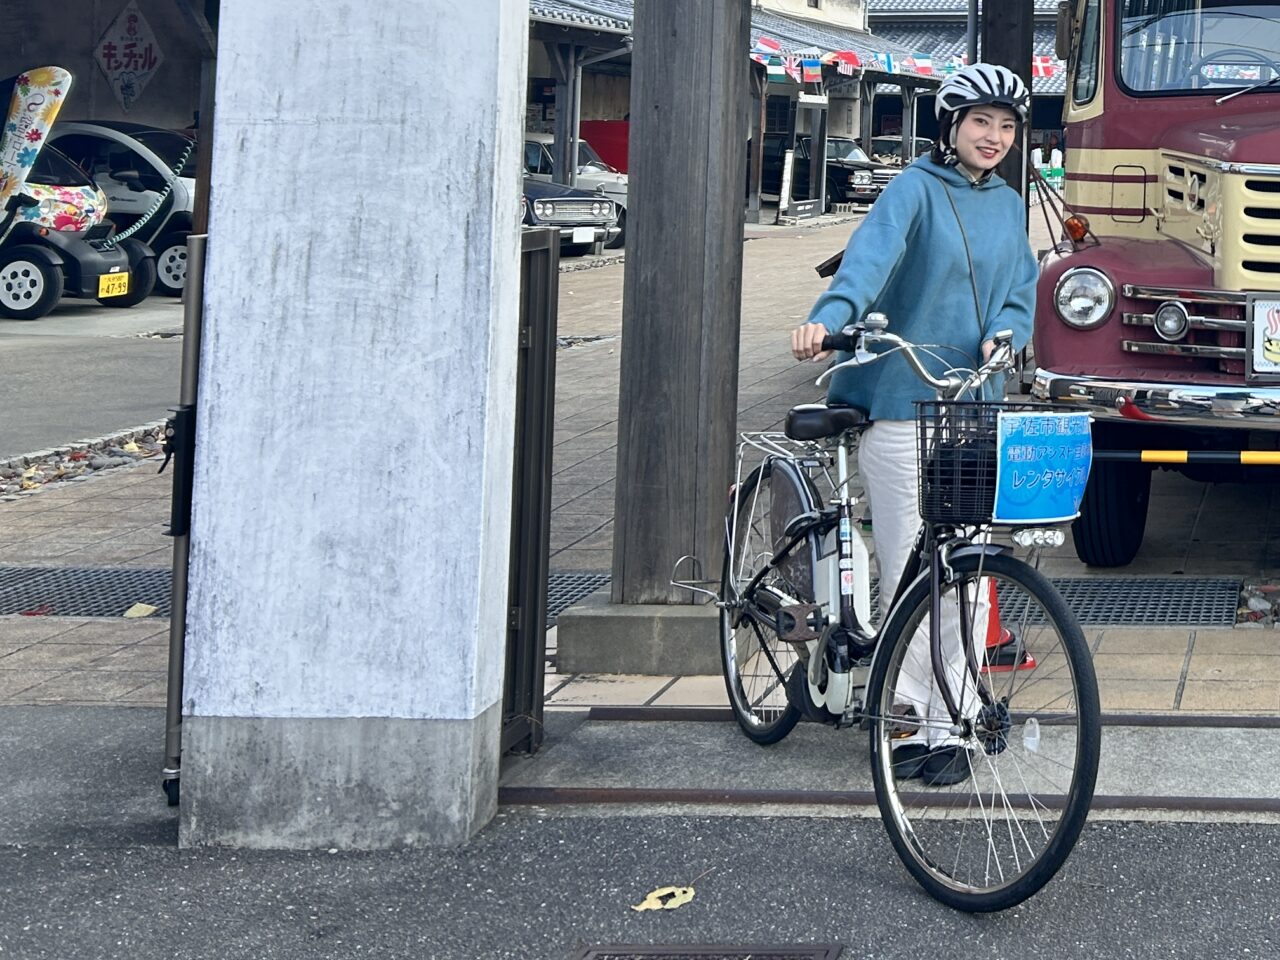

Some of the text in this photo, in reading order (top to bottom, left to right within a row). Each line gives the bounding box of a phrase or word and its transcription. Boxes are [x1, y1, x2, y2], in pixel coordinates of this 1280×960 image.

[103, 41, 157, 71] キンチョール
